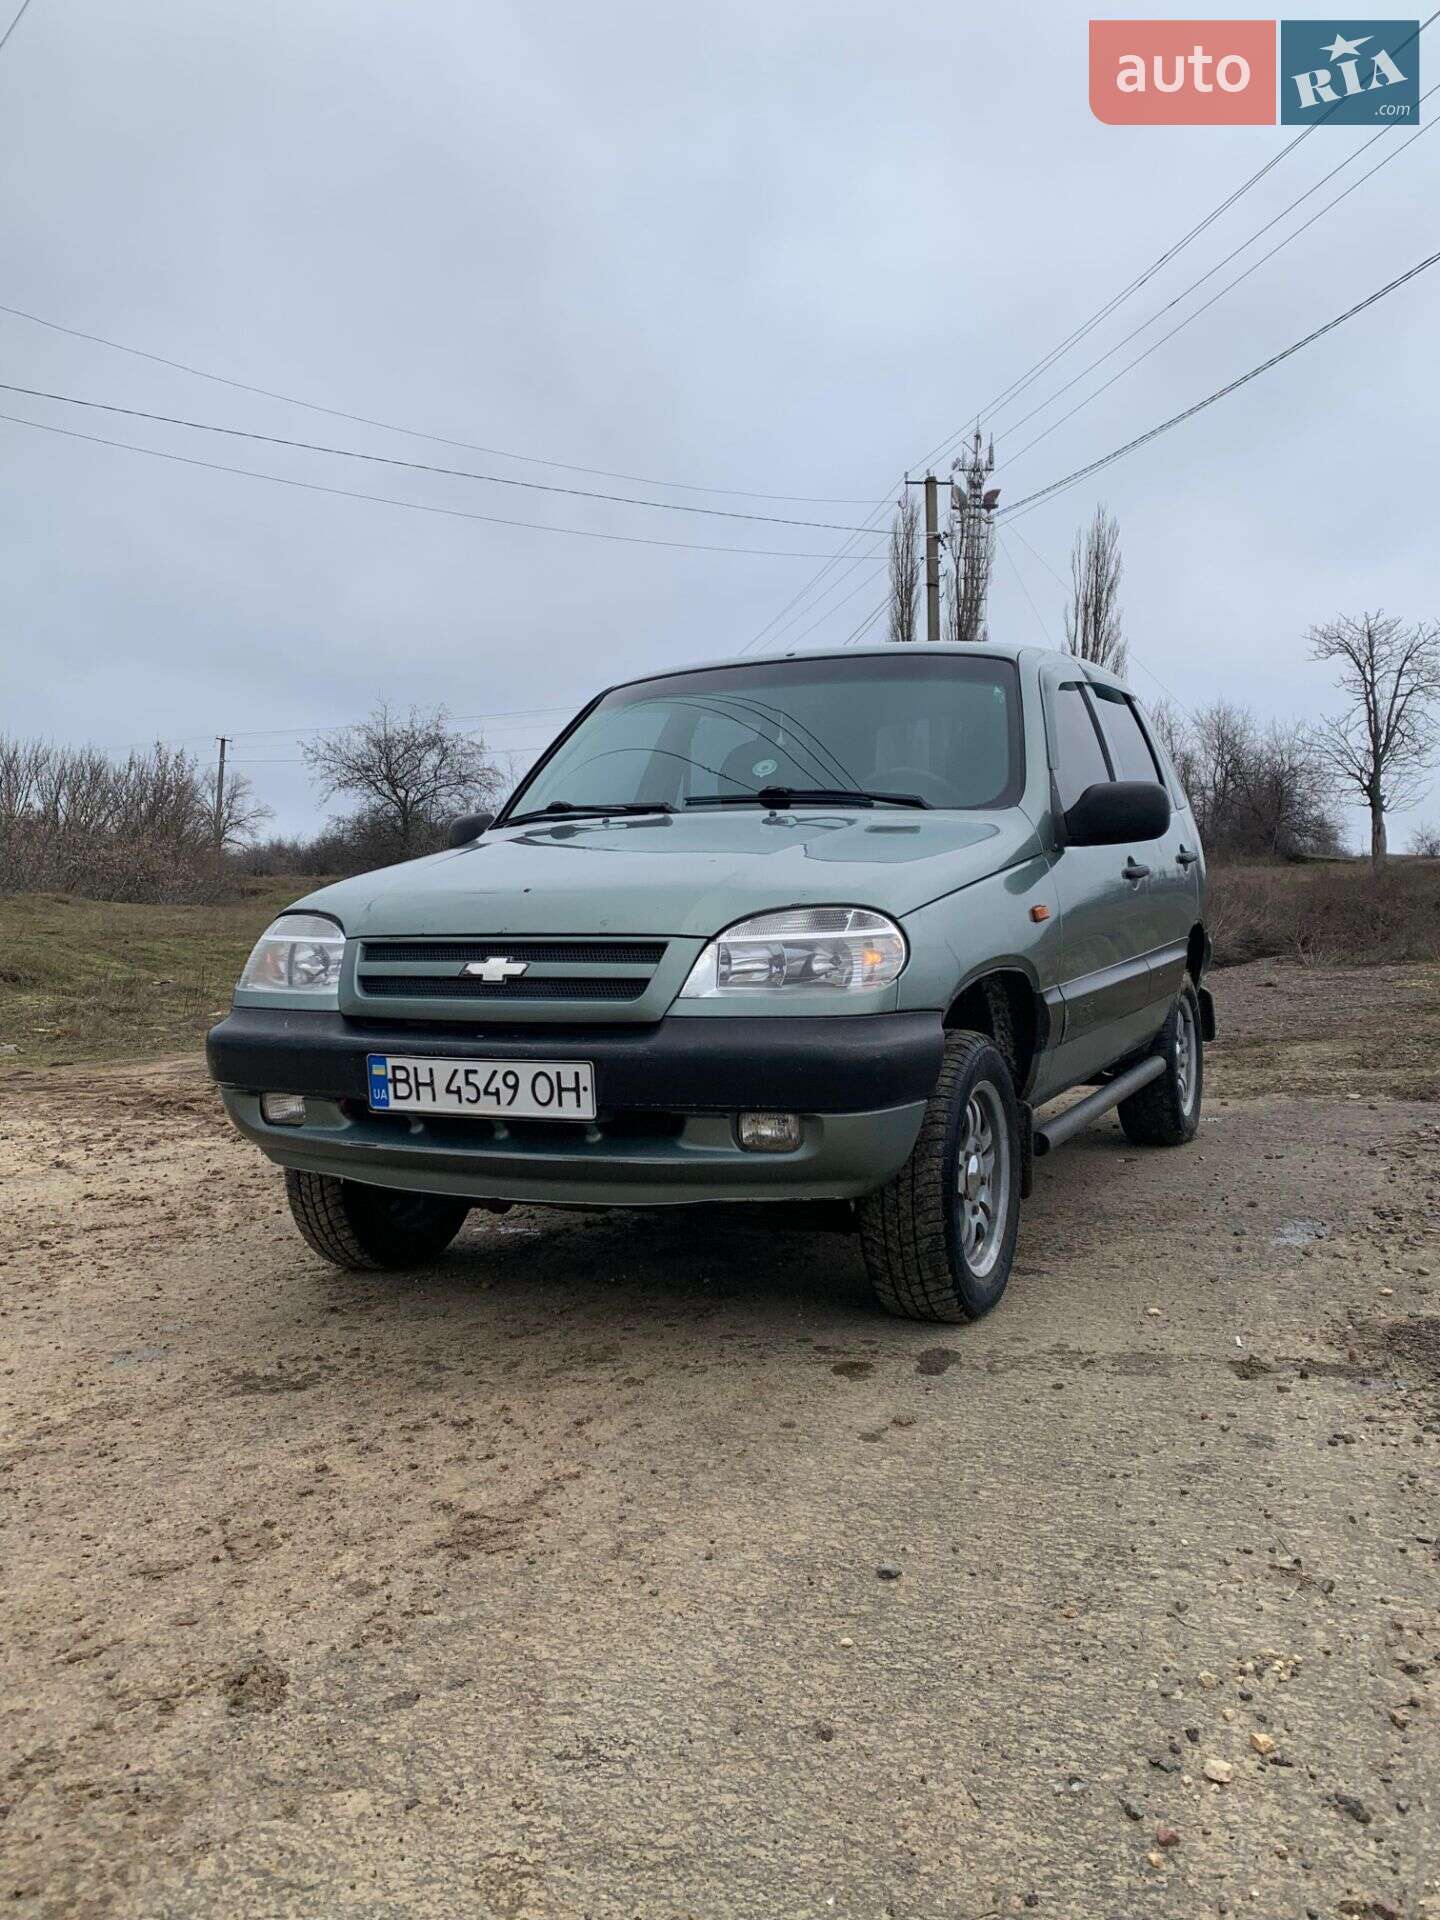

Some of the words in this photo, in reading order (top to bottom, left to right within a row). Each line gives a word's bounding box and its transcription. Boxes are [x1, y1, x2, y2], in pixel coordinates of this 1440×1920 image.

[373, 1090, 388, 1100] UA
[391, 1065, 437, 1102] BH
[445, 1069, 520, 1106] 4549
[531, 1071, 581, 1108] OH
